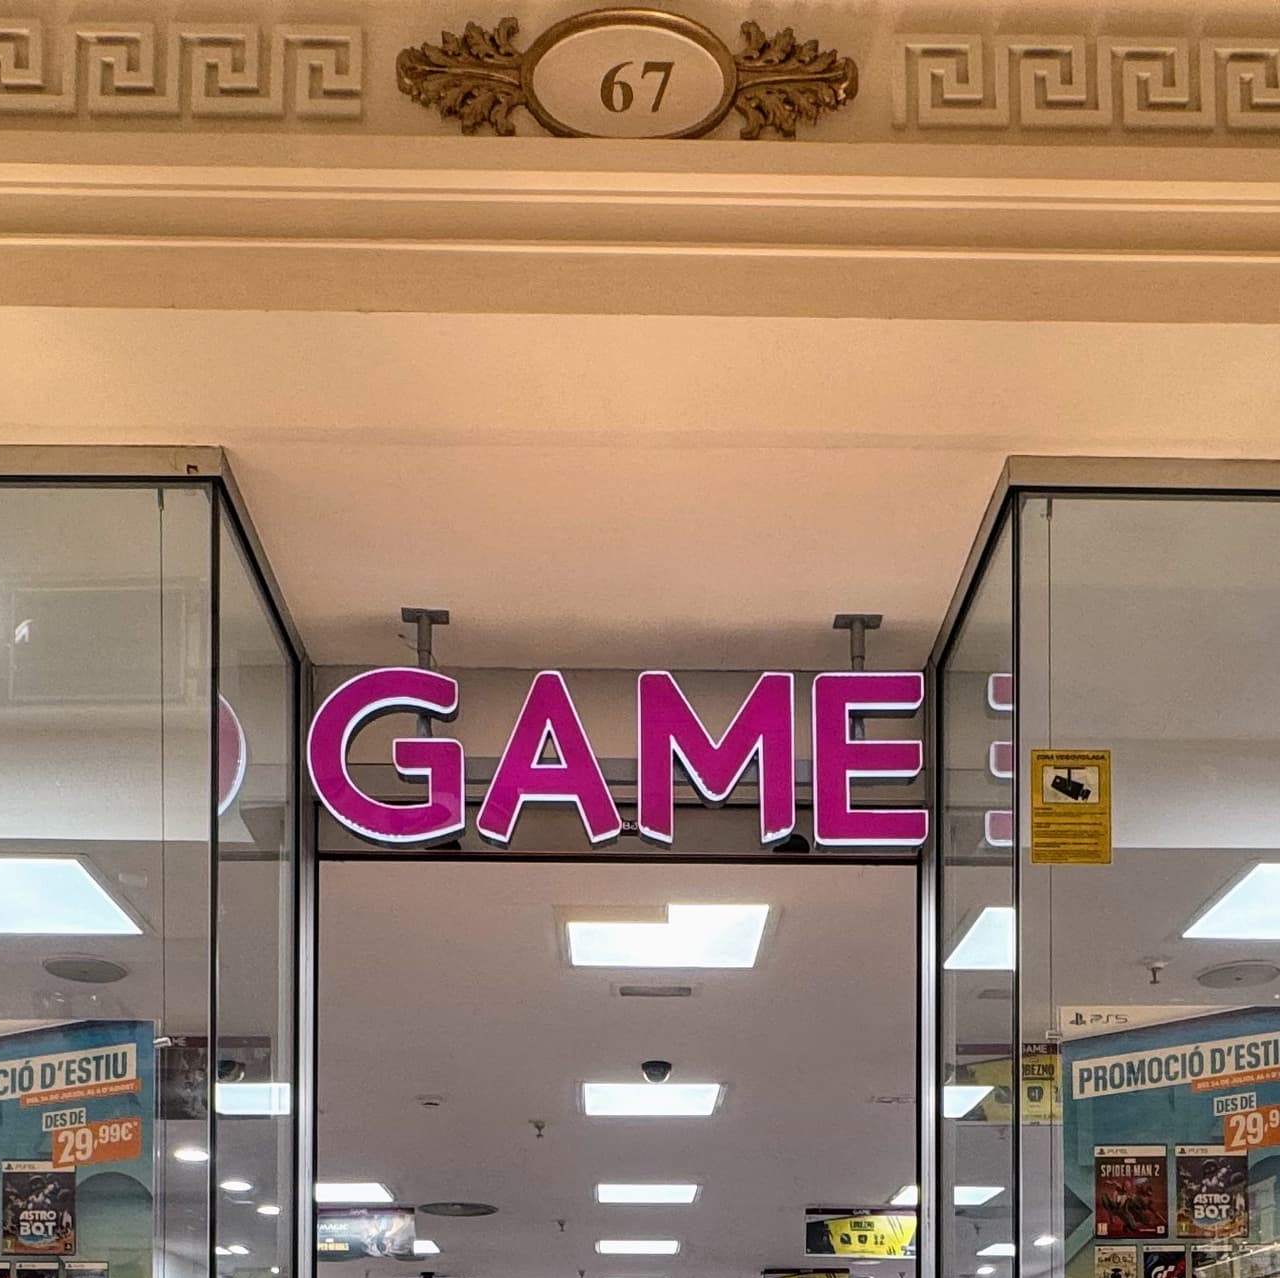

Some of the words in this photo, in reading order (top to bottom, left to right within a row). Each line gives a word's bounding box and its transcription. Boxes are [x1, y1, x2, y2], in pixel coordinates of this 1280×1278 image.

[600, 61, 675, 114] 67
[306, 666, 928, 847] GAME
[1092, 1012, 1131, 1023] PS5
[39, 1052, 128, 1089] D'ESTIU
[1079, 1046, 1205, 1094] PROMOCIÓ
[44, 1112, 68, 1130] DES
[68, 1110, 85, 1126] DE
[1215, 1097, 1239, 1114] DES
[1239, 1094, 1255, 1111] DE
